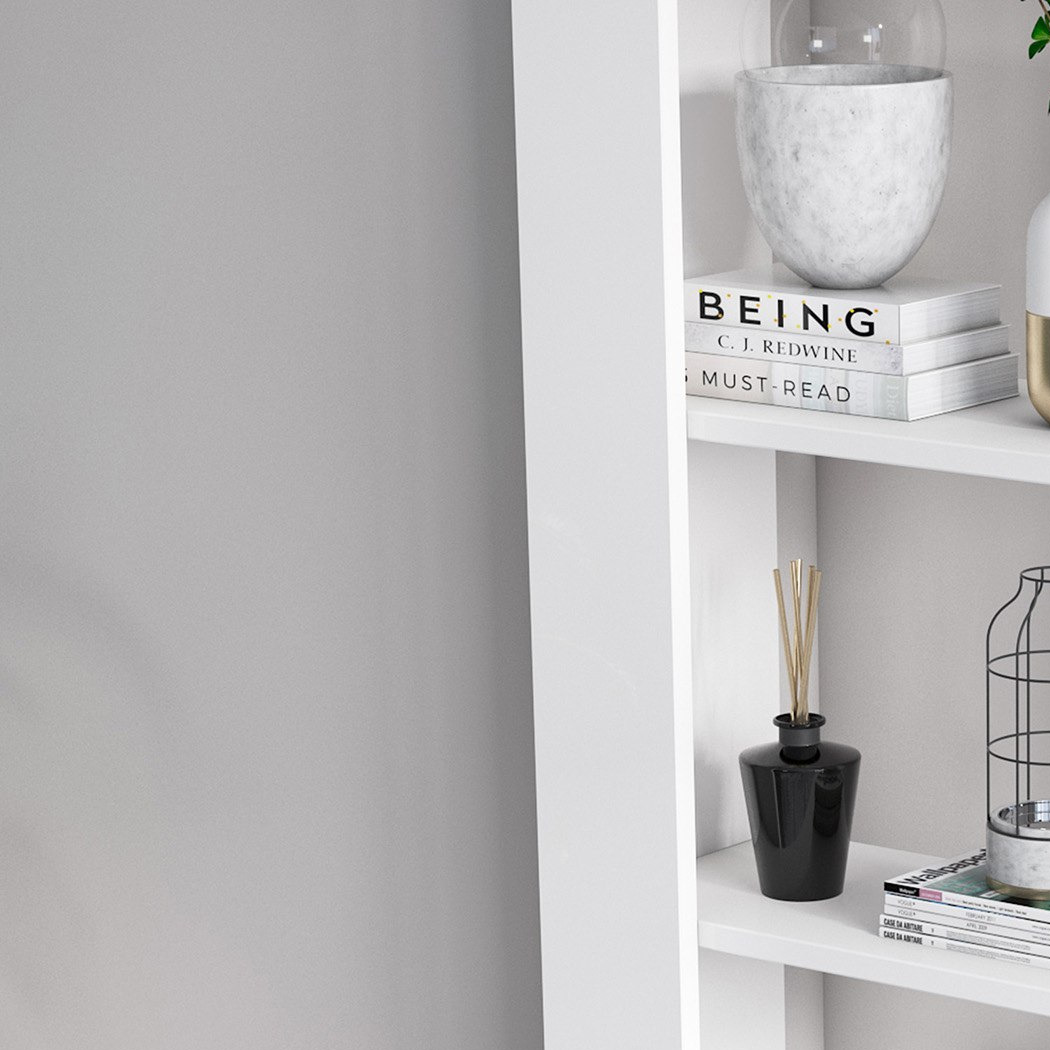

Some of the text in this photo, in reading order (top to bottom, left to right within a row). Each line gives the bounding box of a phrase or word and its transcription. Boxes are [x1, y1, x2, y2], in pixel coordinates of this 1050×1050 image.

[699, 290, 875, 337] BEING
[717, 334, 858, 364] C. J. REDWINE
[702, 370, 851, 403] MUST-READ
